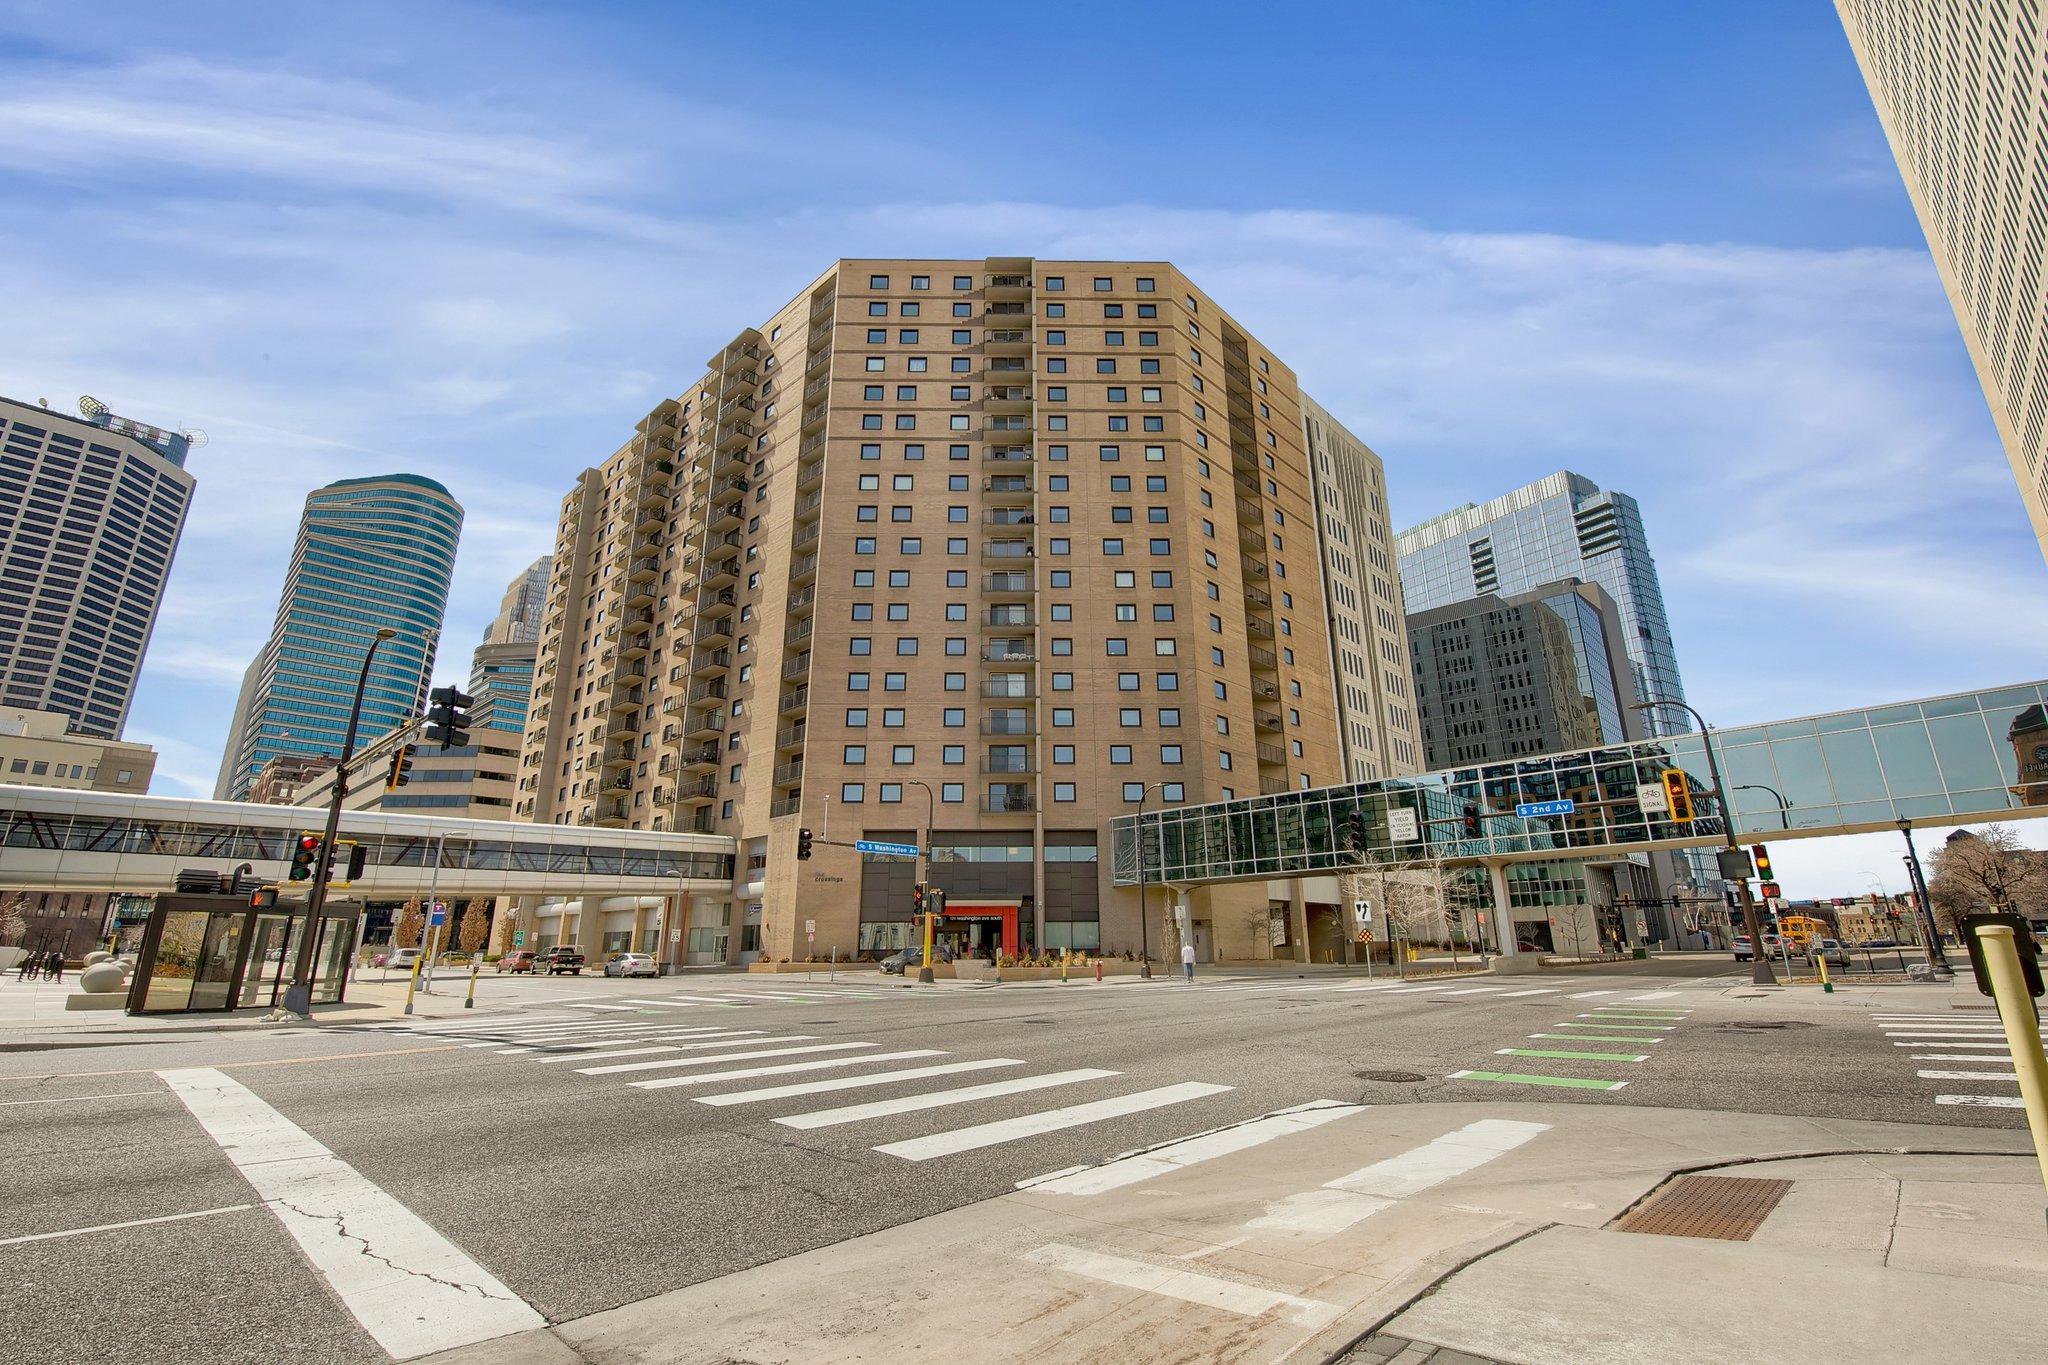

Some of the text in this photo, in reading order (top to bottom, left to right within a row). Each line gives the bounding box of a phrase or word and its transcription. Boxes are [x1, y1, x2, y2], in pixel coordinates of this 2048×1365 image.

[1520, 803, 1569, 815] S 2nd Av
[874, 844, 908, 855] Washington
